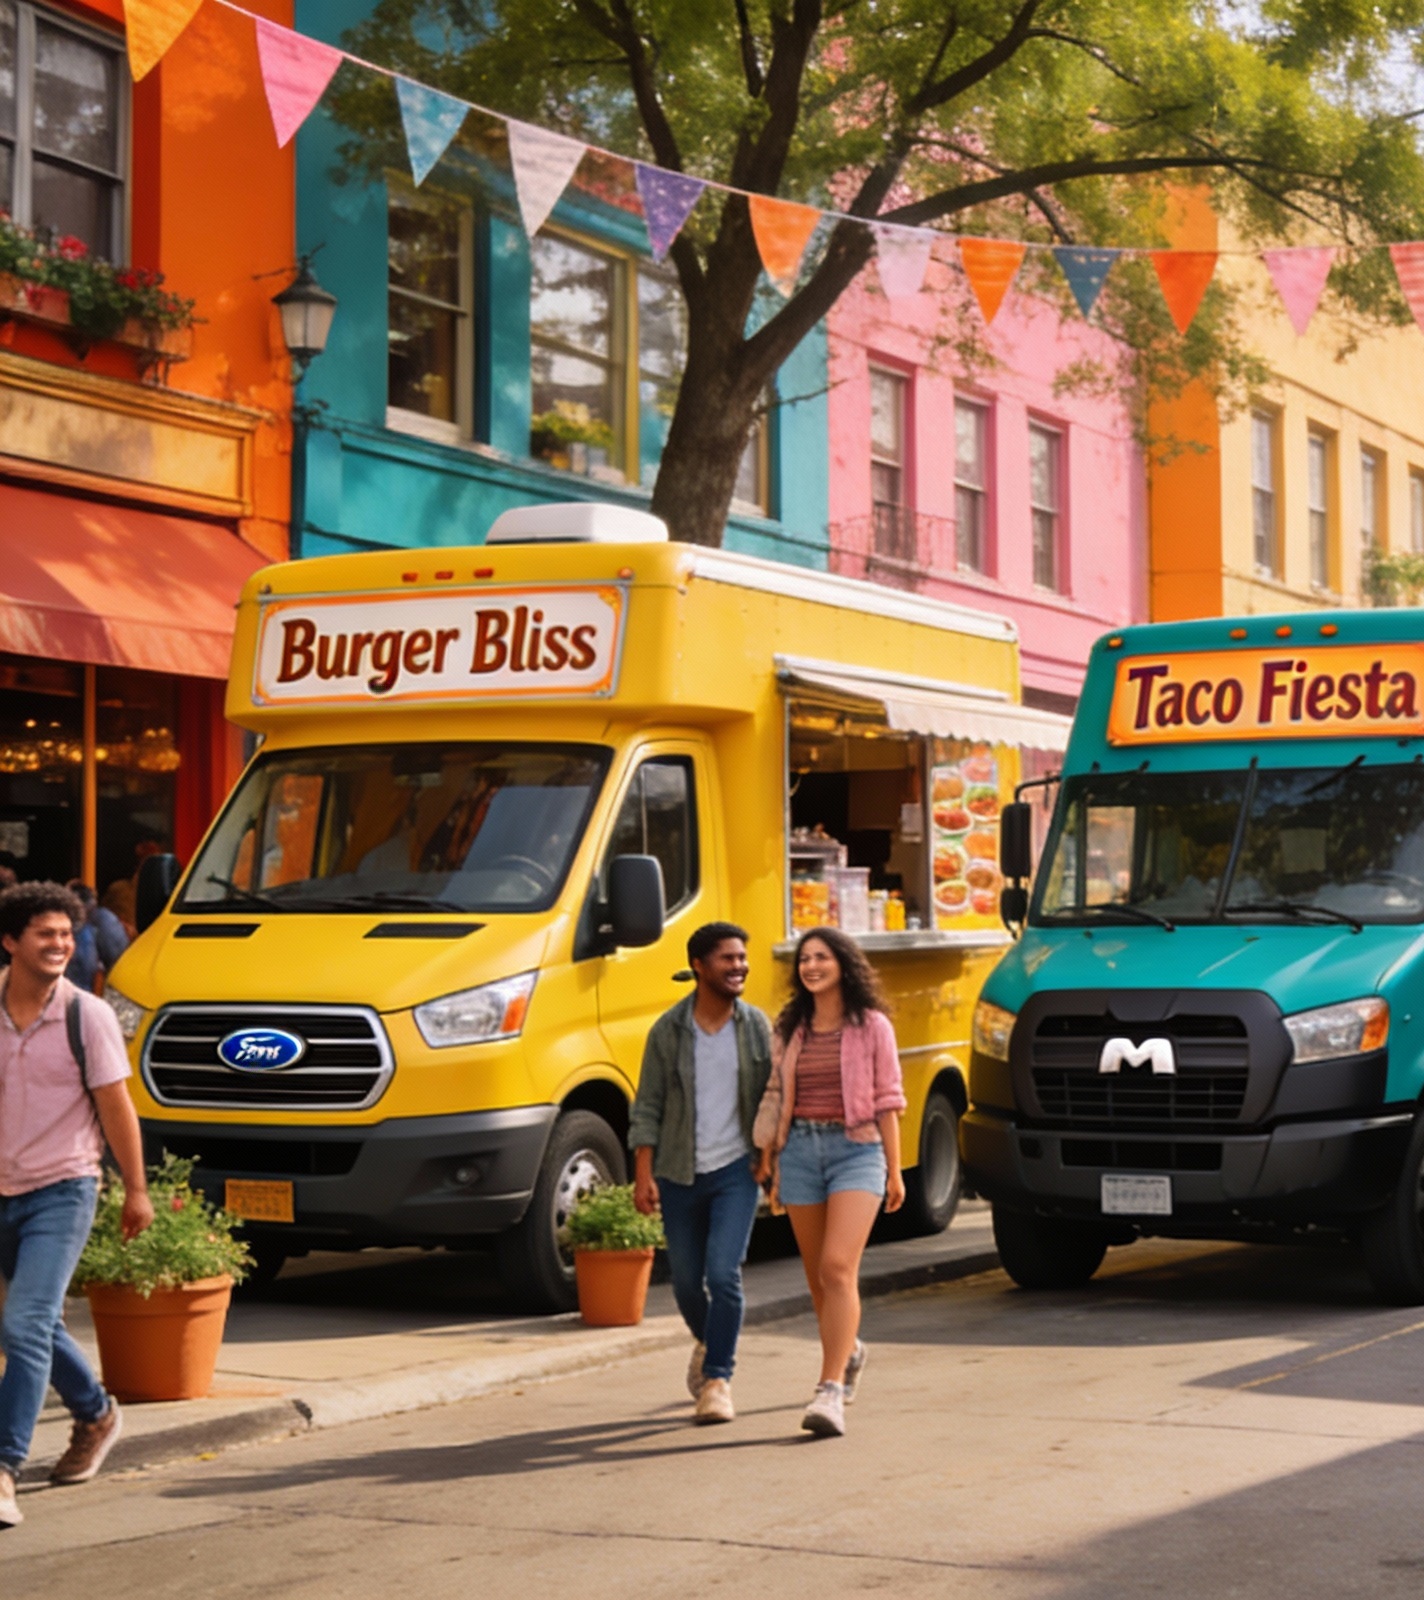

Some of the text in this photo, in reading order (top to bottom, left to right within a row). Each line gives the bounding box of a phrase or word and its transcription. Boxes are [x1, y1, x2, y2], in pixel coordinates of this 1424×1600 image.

[276, 605, 598, 694] Burger Bliss
[1127, 660, 1420, 730] Taco Fiesta
